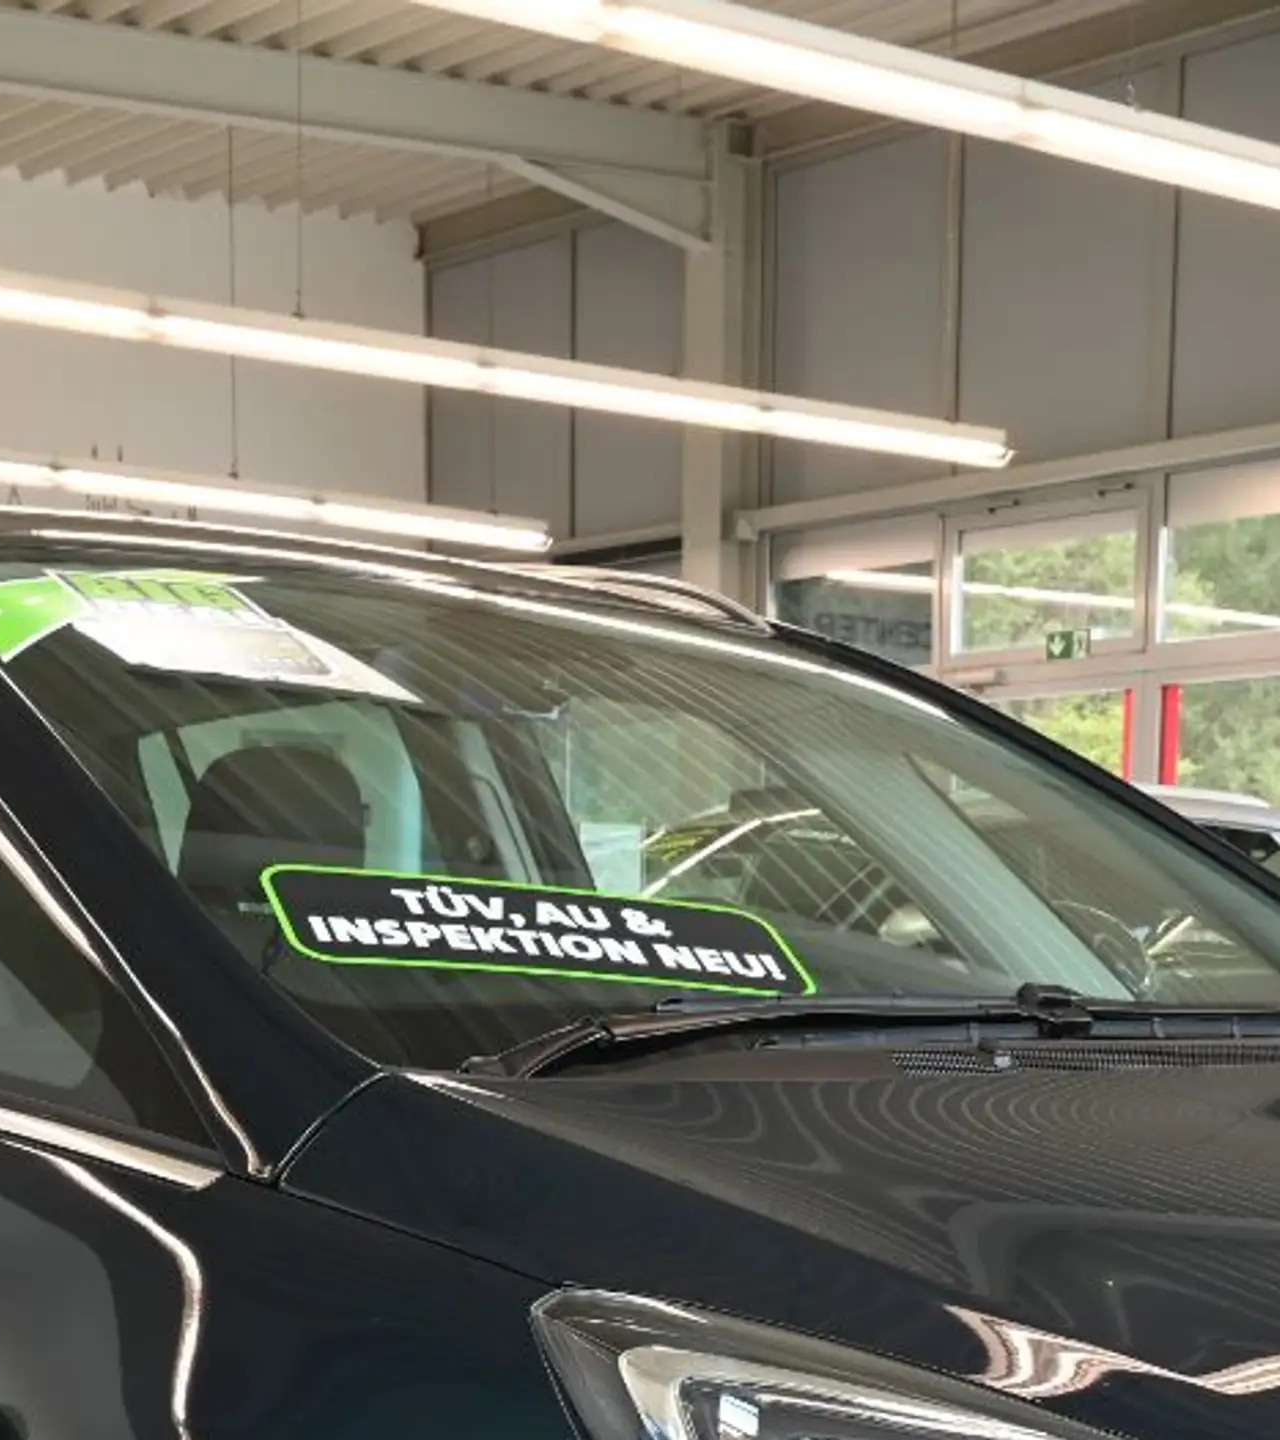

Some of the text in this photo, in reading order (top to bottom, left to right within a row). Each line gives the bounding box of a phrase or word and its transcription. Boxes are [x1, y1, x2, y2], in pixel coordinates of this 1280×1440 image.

[391, 884, 674, 938] TÜV, AU &
[307, 915, 787, 981] INSPEKTION NEU!
